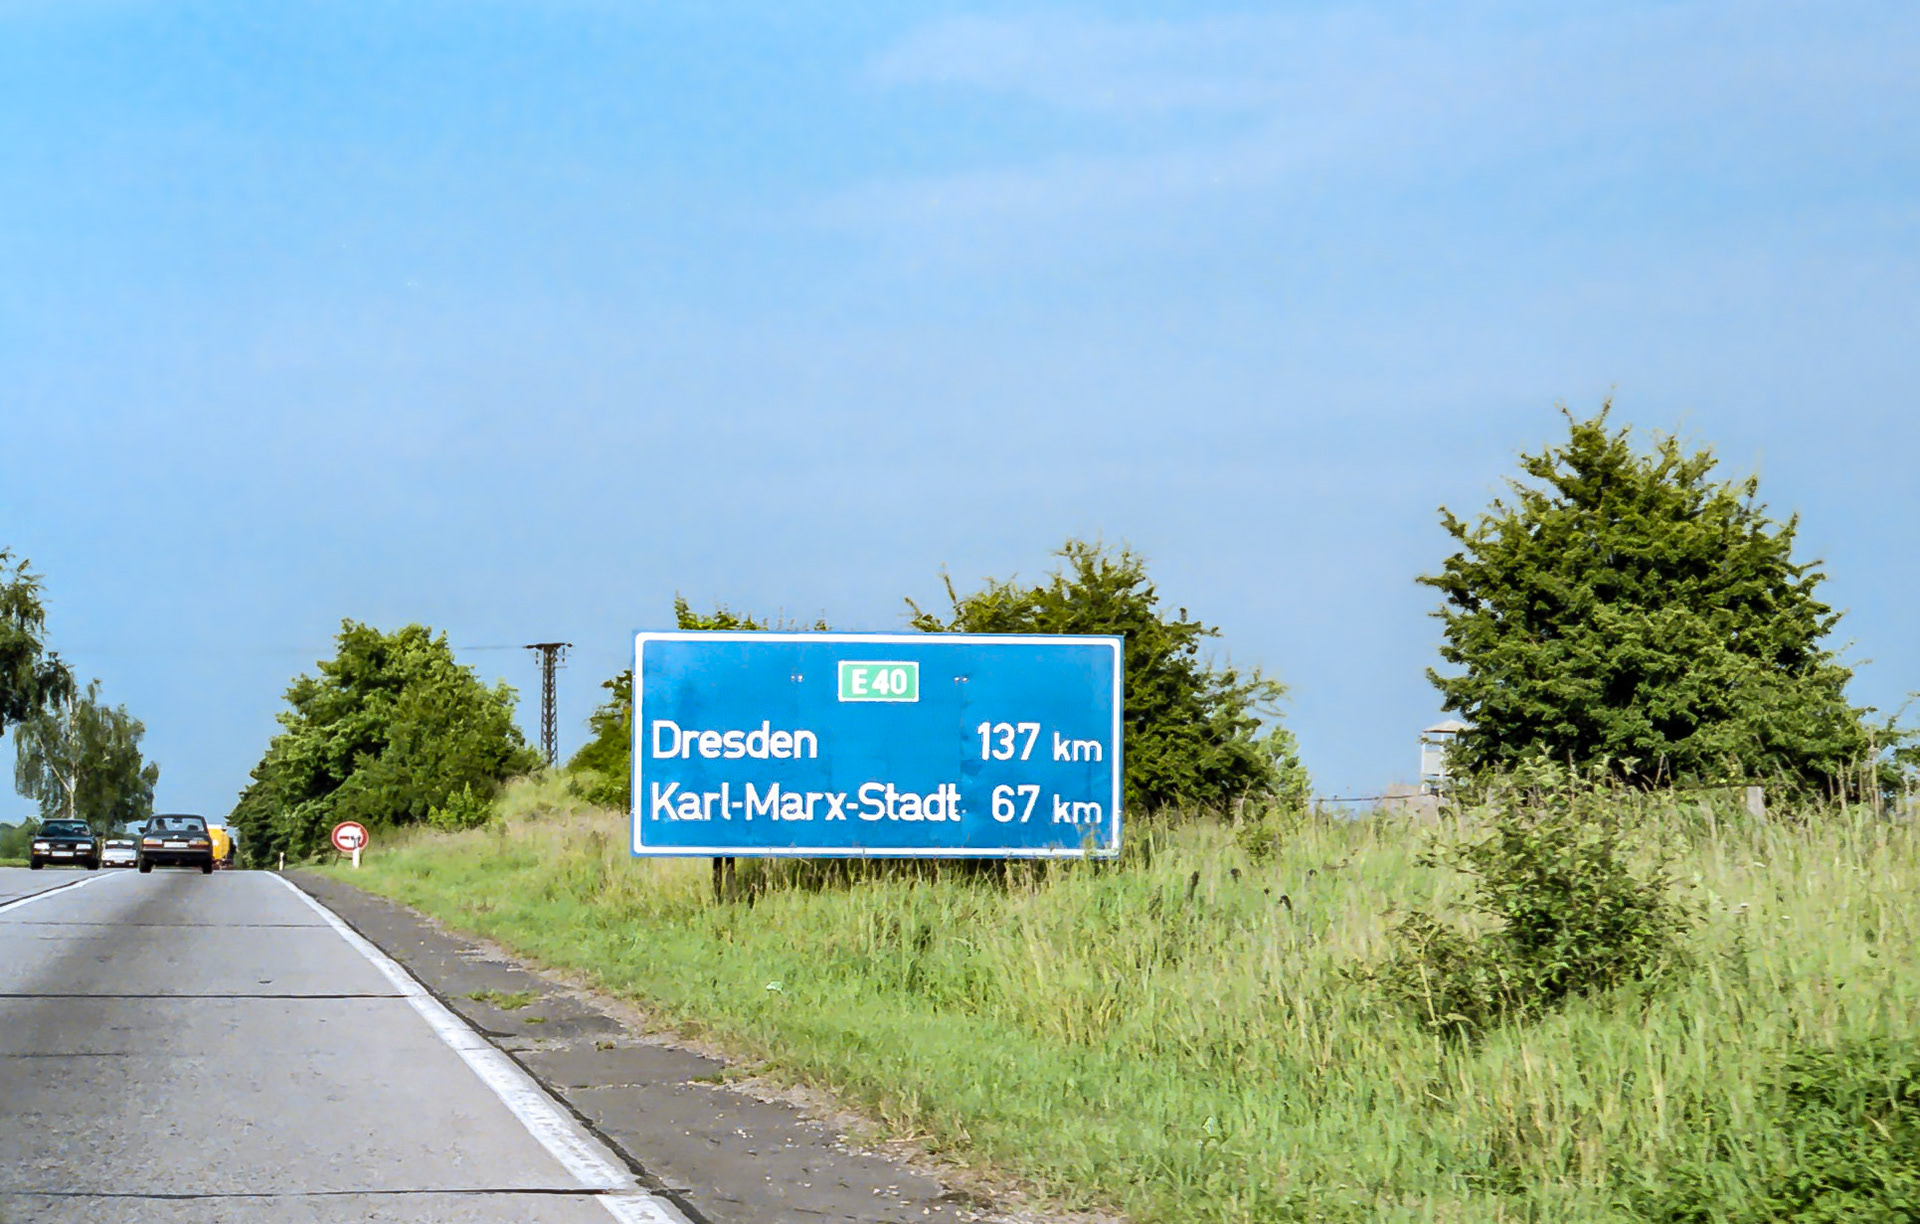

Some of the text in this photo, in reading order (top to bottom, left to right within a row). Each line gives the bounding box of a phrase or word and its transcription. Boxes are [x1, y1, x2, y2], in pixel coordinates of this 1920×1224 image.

[851, 668, 908, 695] E 40
[651, 719, 1102, 762] Dresden 137 km
[650, 781, 1102, 826] Karl-Marx-Stadt 67 km
